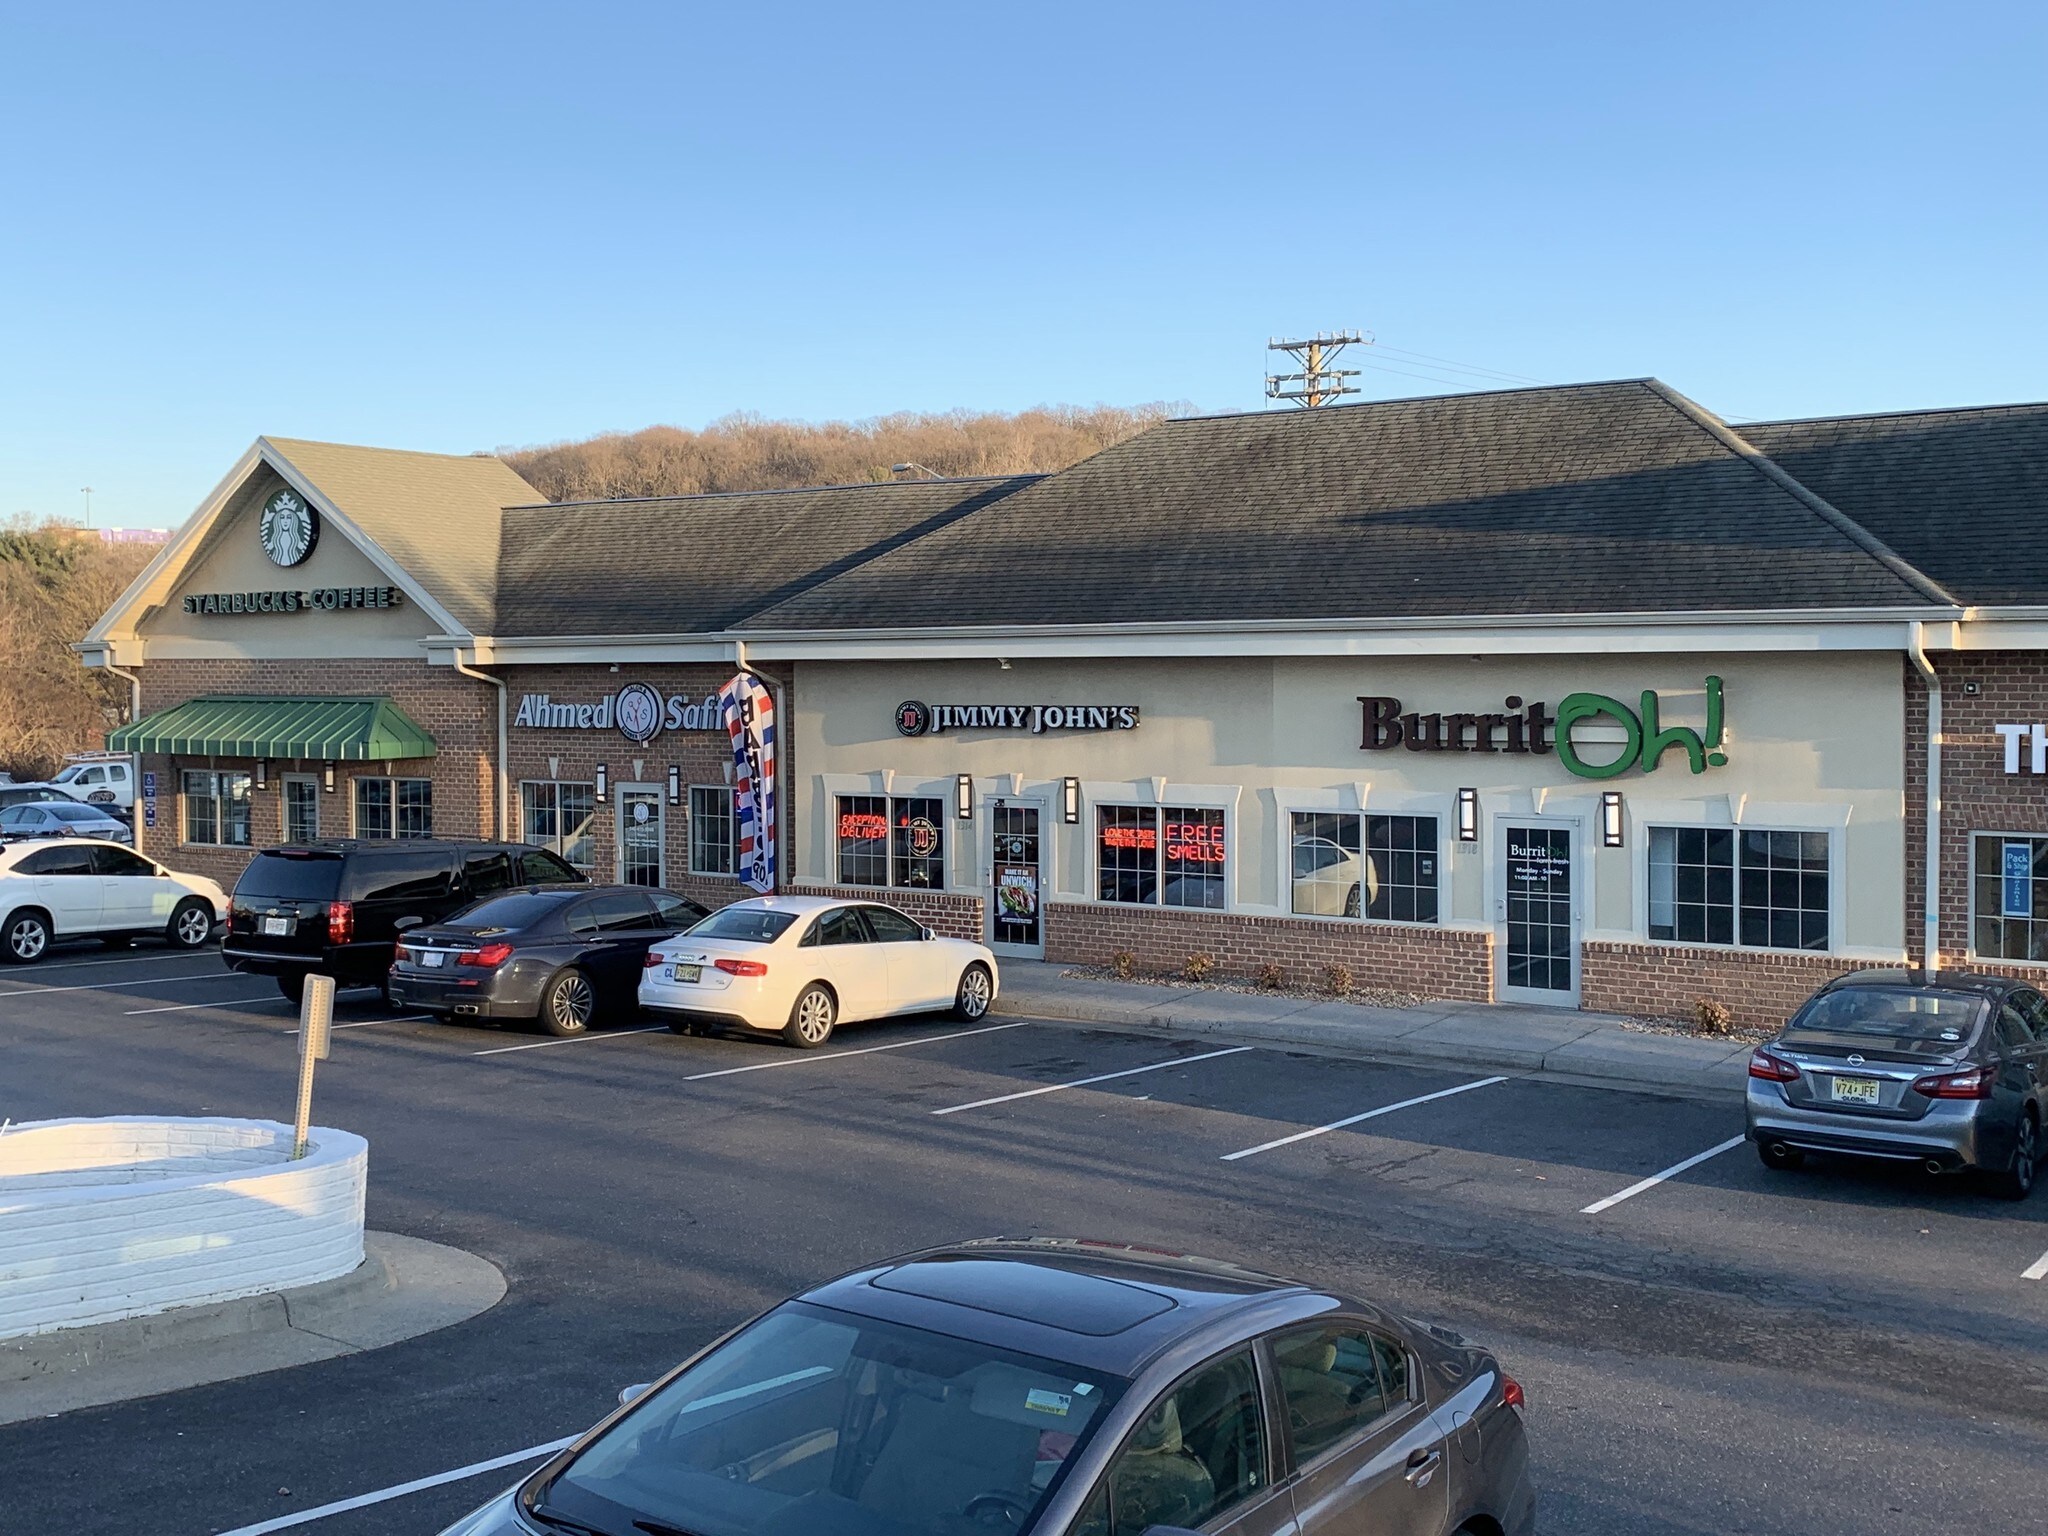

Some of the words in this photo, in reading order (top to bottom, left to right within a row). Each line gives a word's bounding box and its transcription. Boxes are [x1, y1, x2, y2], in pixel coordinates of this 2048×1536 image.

[182, 591, 298, 615] STARBUCKS
[309, 586, 390, 610] COFFEE
[514, 694, 615, 729] Ahmed
[931, 705, 1029, 733] JIMMY
[1032, 705, 1139, 734] JOHN'S
[842, 814, 888, 826] EXCEPTION
[841, 826, 888, 839] DELIVER
[1166, 824, 1224, 846] FREE
[1167, 845, 1225, 861] SMELLS
[2007, 853, 2028, 863] Pack
[1516, 867, 1538, 875] Monday
[1543, 868, 1563, 876] Sunday
[2013, 862, 2028, 871] Ship
[1001, 875, 1032, 887] UNWICH
